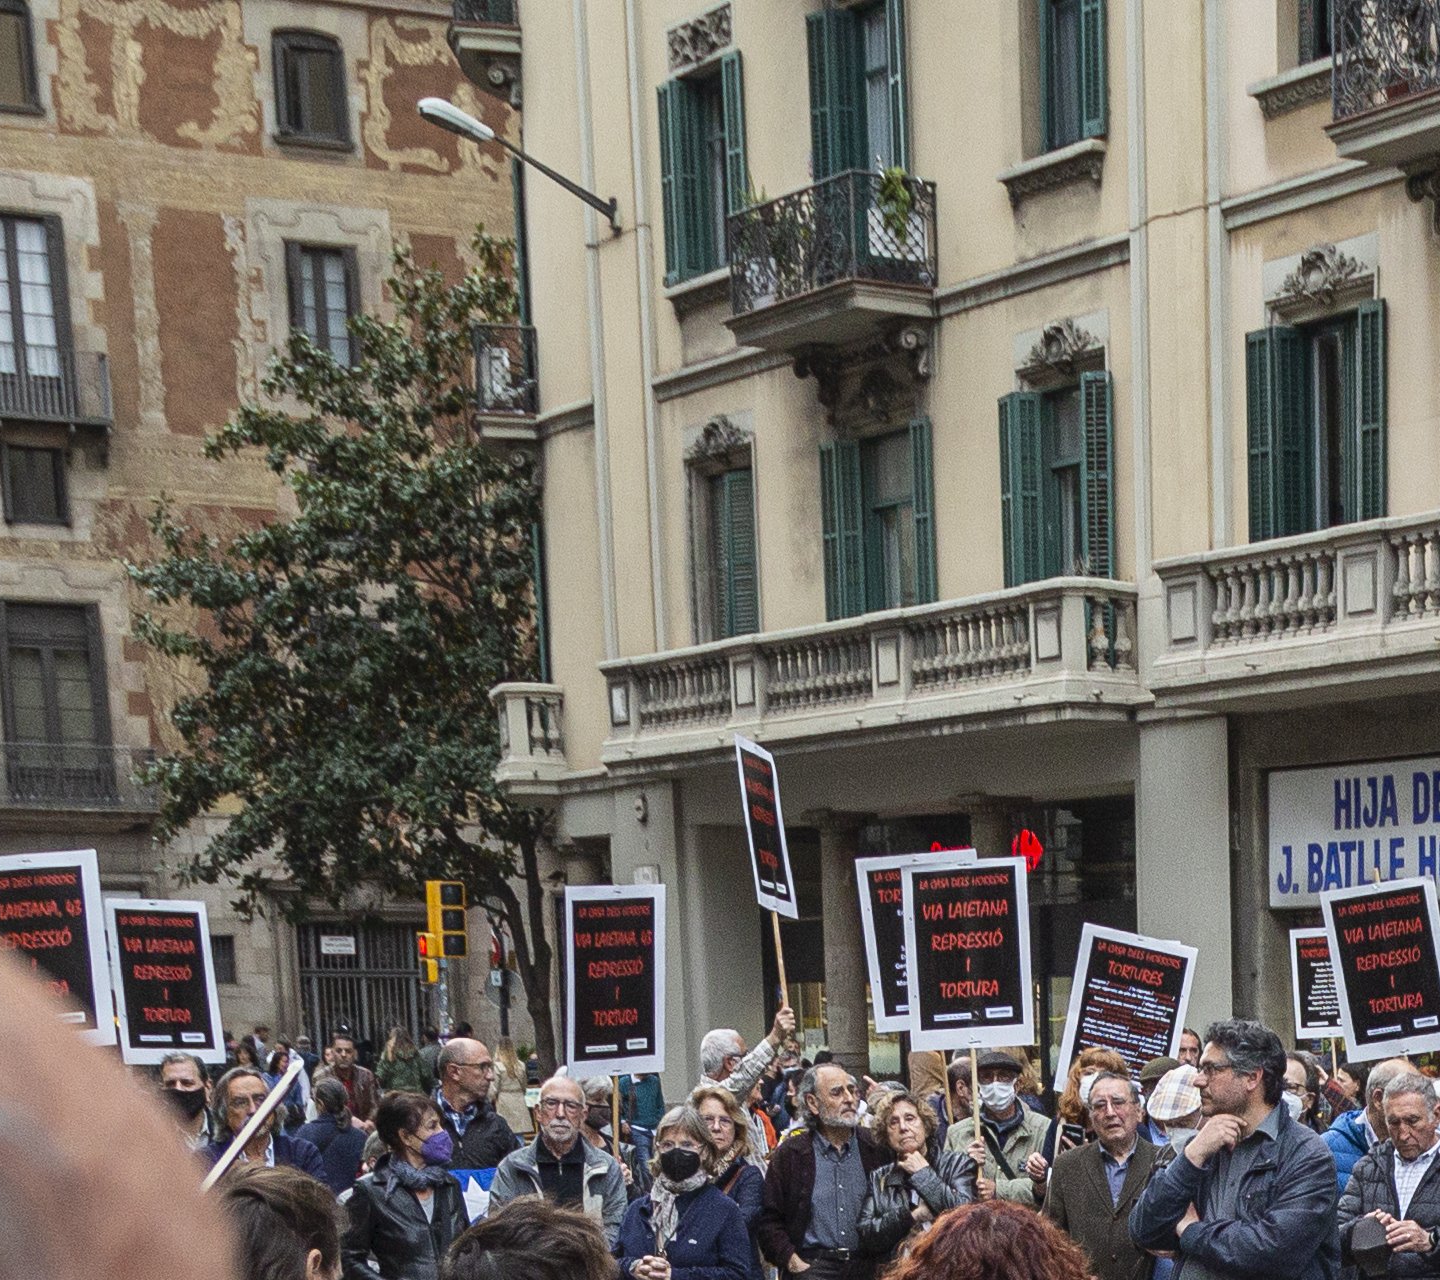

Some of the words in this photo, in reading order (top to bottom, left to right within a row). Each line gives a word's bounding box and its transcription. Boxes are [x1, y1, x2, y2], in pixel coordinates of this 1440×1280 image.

[1334, 774, 1399, 830] HIJA
[1278, 845, 1299, 894] J.
[1307, 837, 1405, 893] BATLLE
[919, 880, 929, 890] LA
[930, 877, 949, 890] CASA
[951, 877, 970, 888] DELS
[971, 874, 1009, 886] HORRORS
[922, 903, 943, 921] VIA
[948, 899, 1008, 919] LAIETANA
[1338, 907, 1347, 917] LA
[1348, 904, 1366, 916] CASA
[1385, 893, 1420, 909] HORRORS
[576, 931, 592, 948] VIA
[931, 928, 1004, 951] REPRESSIÓ
[1344, 928, 1364, 944] VIA
[1368, 916, 1423, 940] LAIETANA
[123, 937, 143, 952] VIA
[145, 937, 195, 954] LAIETANA
[1098, 941, 1107, 951] LA
[1108, 944, 1127, 956] CASA
[1128, 948, 1145, 961] DELS
[1146, 953, 1182, 969] HORRORS
[588, 956, 644, 979] REPRESSIÓ
[966, 957, 971, 973] I
[1356, 945, 1421, 971] REPRESSIÓ
[133, 964, 193, 981] REPRESSIÓ
[1108, 960, 1164, 986] TORTURES
[1390, 975, 1395, 988] I
[163, 987, 169, 1001] I
[615, 984, 621, 1000] I
[940, 979, 999, 999] TORTURA
[1369, 991, 1423, 1013] TORTURA
[143, 1007, 192, 1023] TORTURA
[592, 1008, 638, 1026] TORTURA
